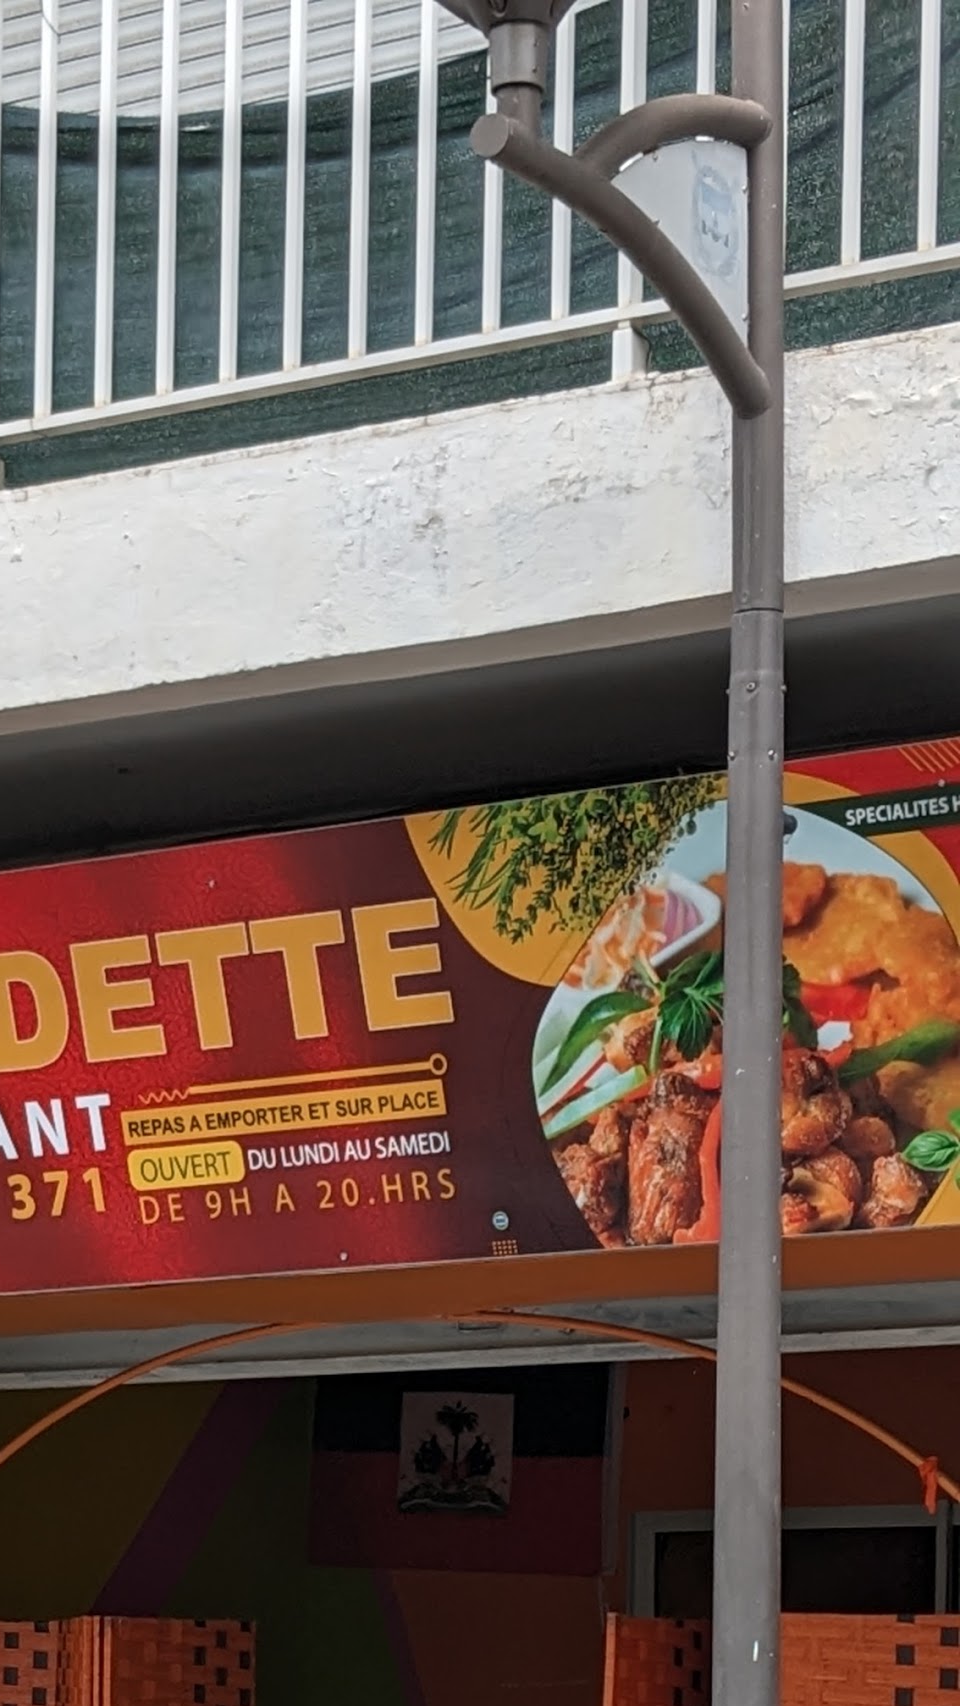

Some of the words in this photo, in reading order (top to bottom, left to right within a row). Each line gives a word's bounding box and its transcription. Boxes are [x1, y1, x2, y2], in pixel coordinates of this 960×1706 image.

[845, 797, 949, 826] SPECIALITES
[127, 1116, 185, 1139] REPAS
[190, 1115, 202, 1132] A
[206, 1104, 303, 1131] EMPORTER
[308, 1102, 330, 1120] ET
[335, 1098, 372, 1118] SUR
[378, 1090, 440, 1113] PLACE
[139, 1151, 231, 1183] OUVERT
[247, 1149, 277, 1171] DU
[280, 1141, 340, 1168] LUNDI
[344, 1139, 371, 1162] AU
[375, 1131, 451, 1159] SAMEDI
[8, 1168, 107, 1220] 371
[139, 1194, 186, 1225] DE
[205, 1187, 252, 1219] 9H
[275, 1183, 296, 1214] A
